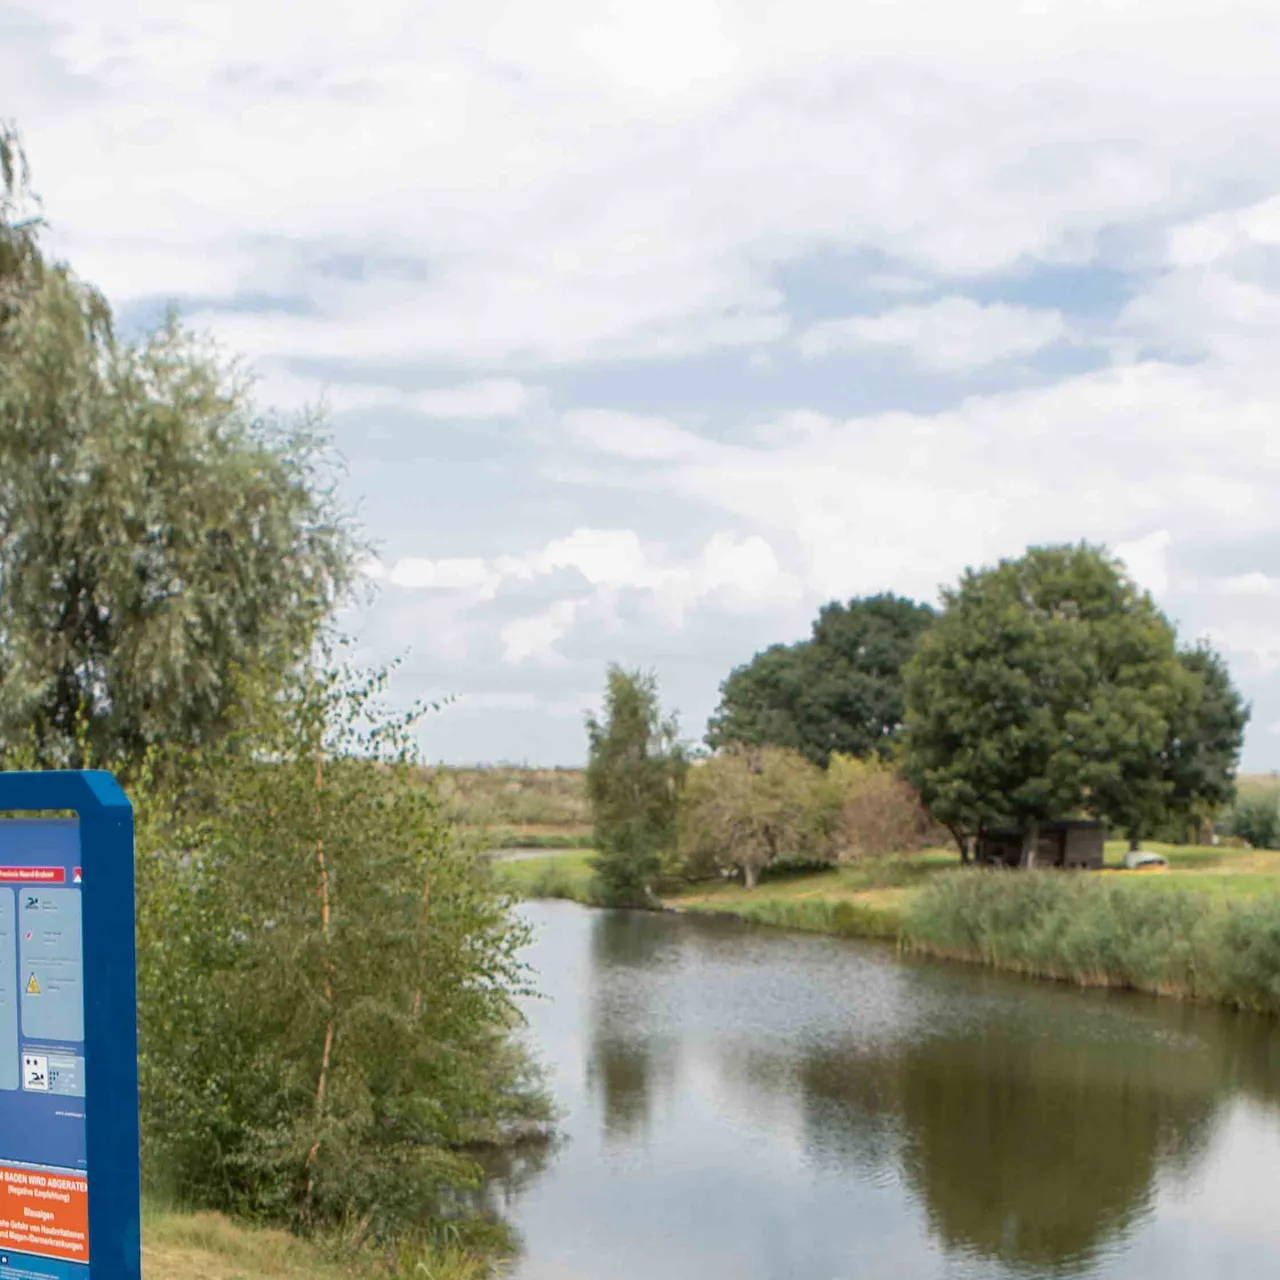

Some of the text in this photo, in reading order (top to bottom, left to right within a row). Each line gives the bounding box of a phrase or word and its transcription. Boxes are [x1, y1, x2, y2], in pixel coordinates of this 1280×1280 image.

[4, 1171, 28, 1185] BADEN
[28, 1174, 47, 1187] WIRD
[7, 1184, 34, 1197] (Negative
[29, 1224, 41, 1232] von
